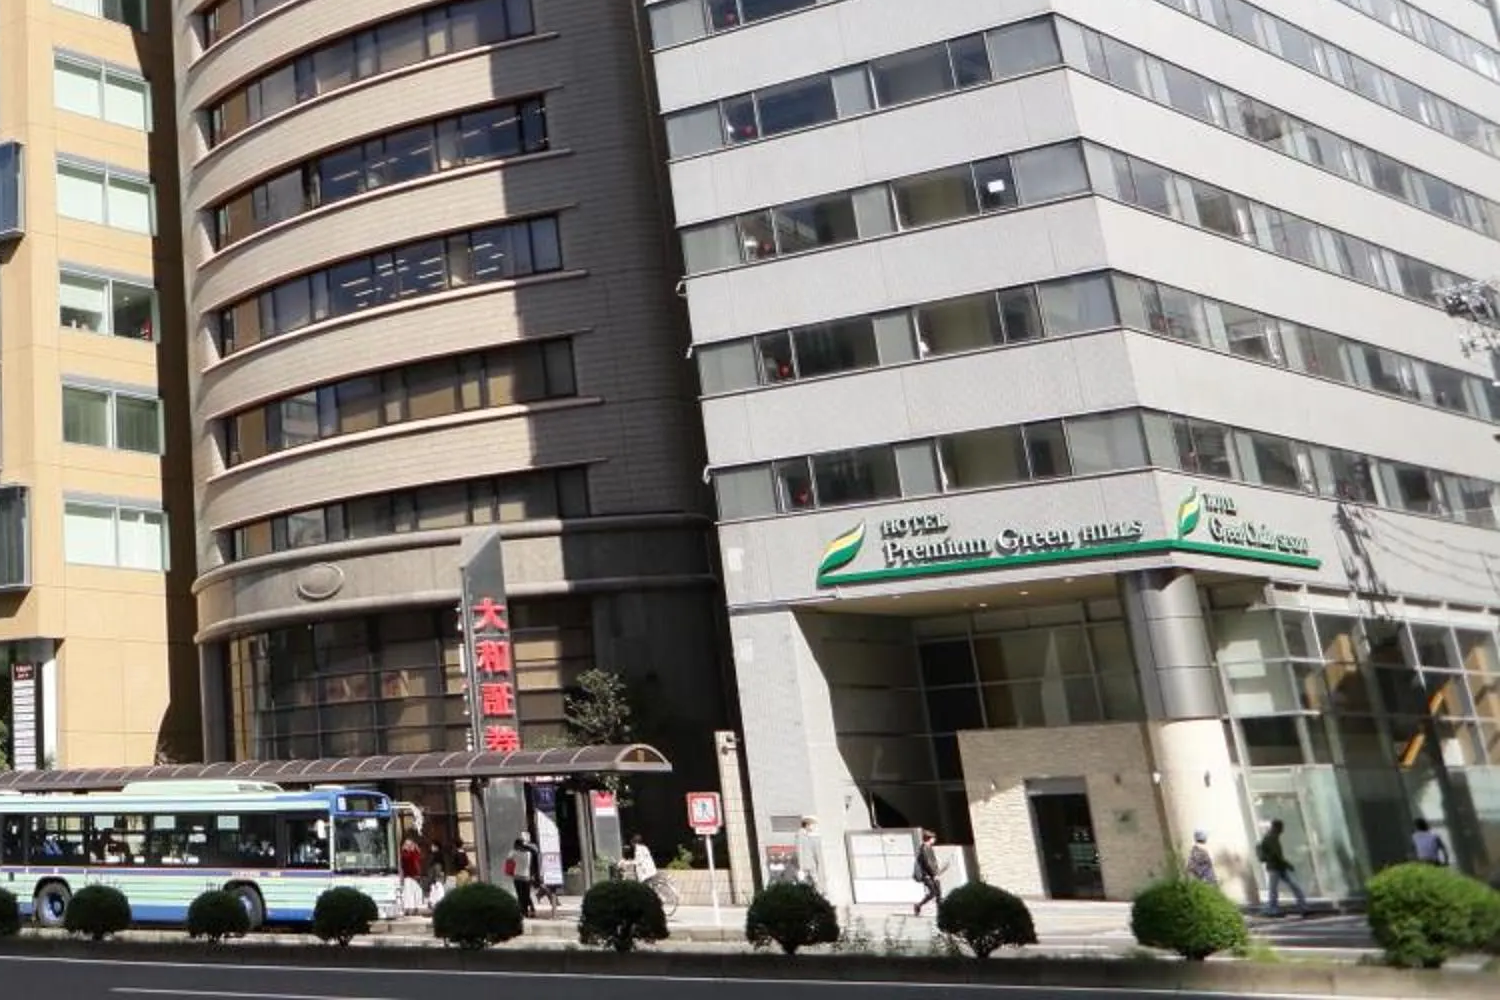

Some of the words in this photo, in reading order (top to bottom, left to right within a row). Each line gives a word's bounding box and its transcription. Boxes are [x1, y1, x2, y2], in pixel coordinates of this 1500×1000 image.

[881, 513, 948, 536] HOTEL
[883, 536, 990, 567] Premium
[997, 527, 1075, 555] Green
[471, 596, 520, 756] 大和証券
